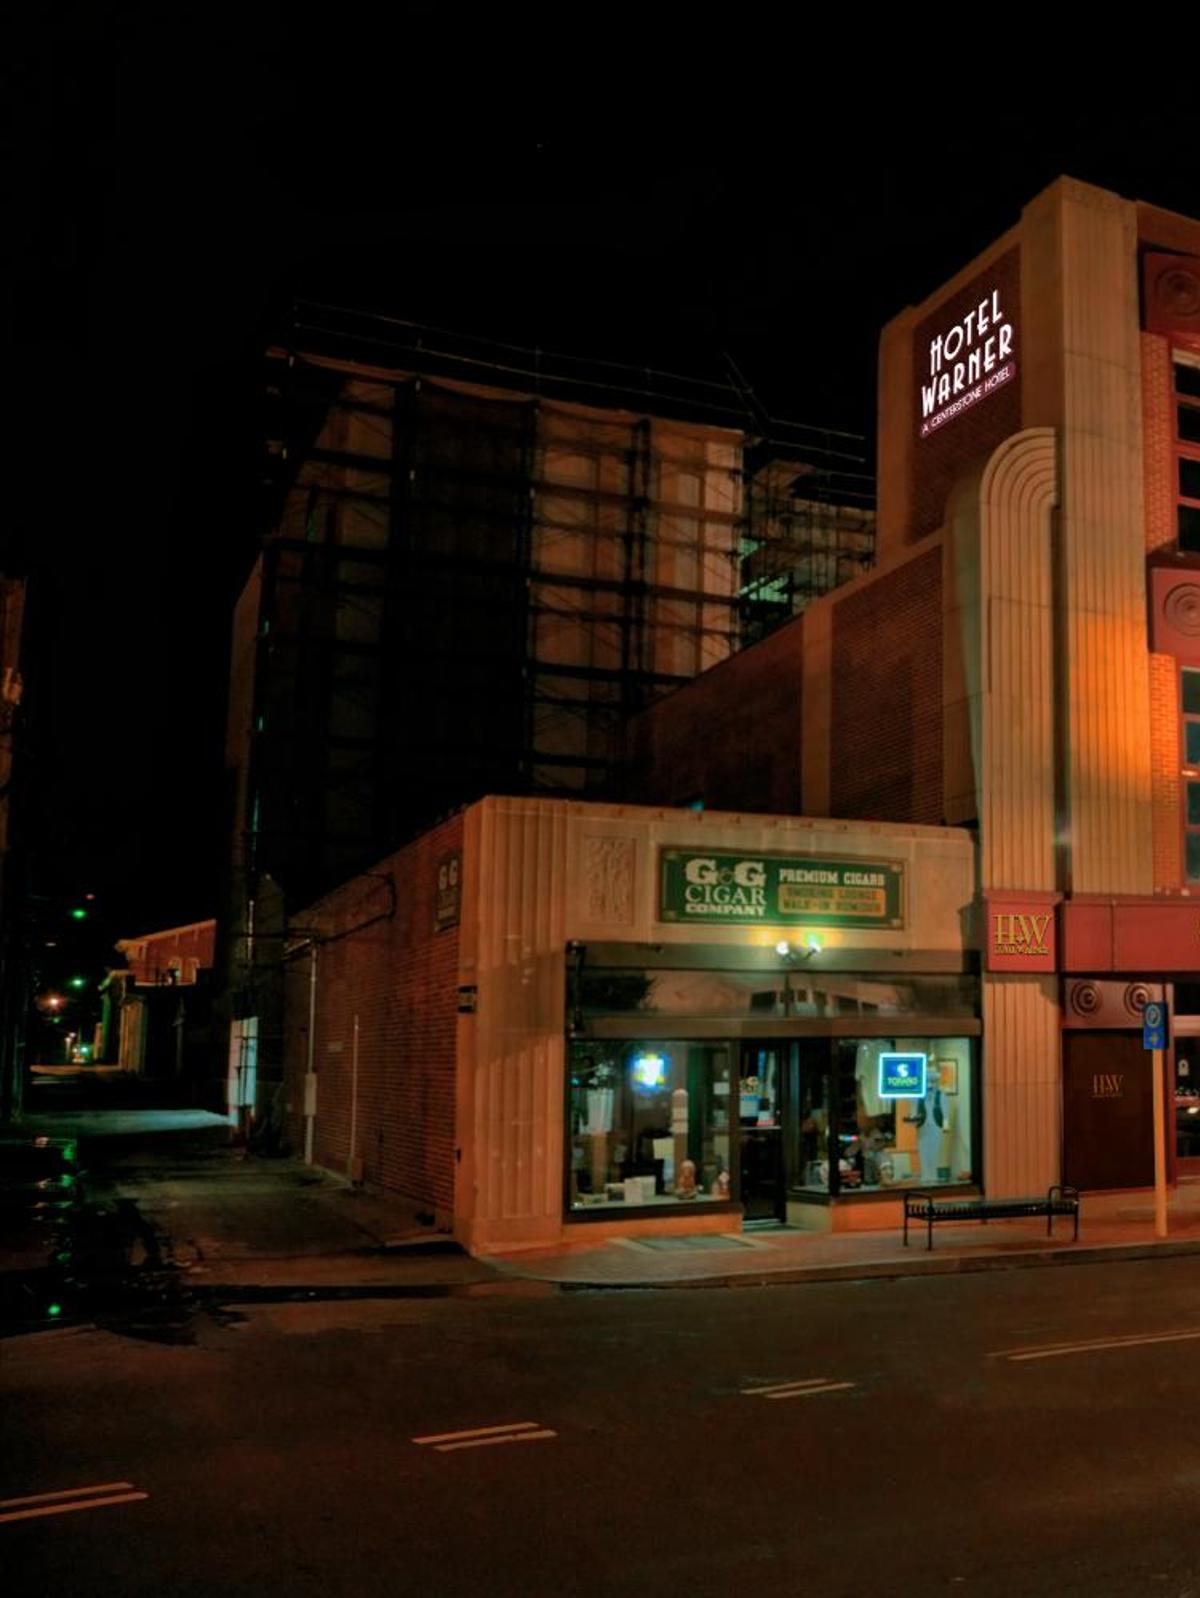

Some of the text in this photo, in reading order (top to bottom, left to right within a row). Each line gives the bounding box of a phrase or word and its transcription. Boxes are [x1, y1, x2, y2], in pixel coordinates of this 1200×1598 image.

[930, 289, 1003, 376] HOTEL
[921, 323, 1013, 418] WARNER
[984, 367, 1010, 392] HOTEL
[779, 868, 885, 886] PREMIUM CIGARS
[685, 884, 767, 905] CIGAR
[685, 904, 765, 916] COMPANY
